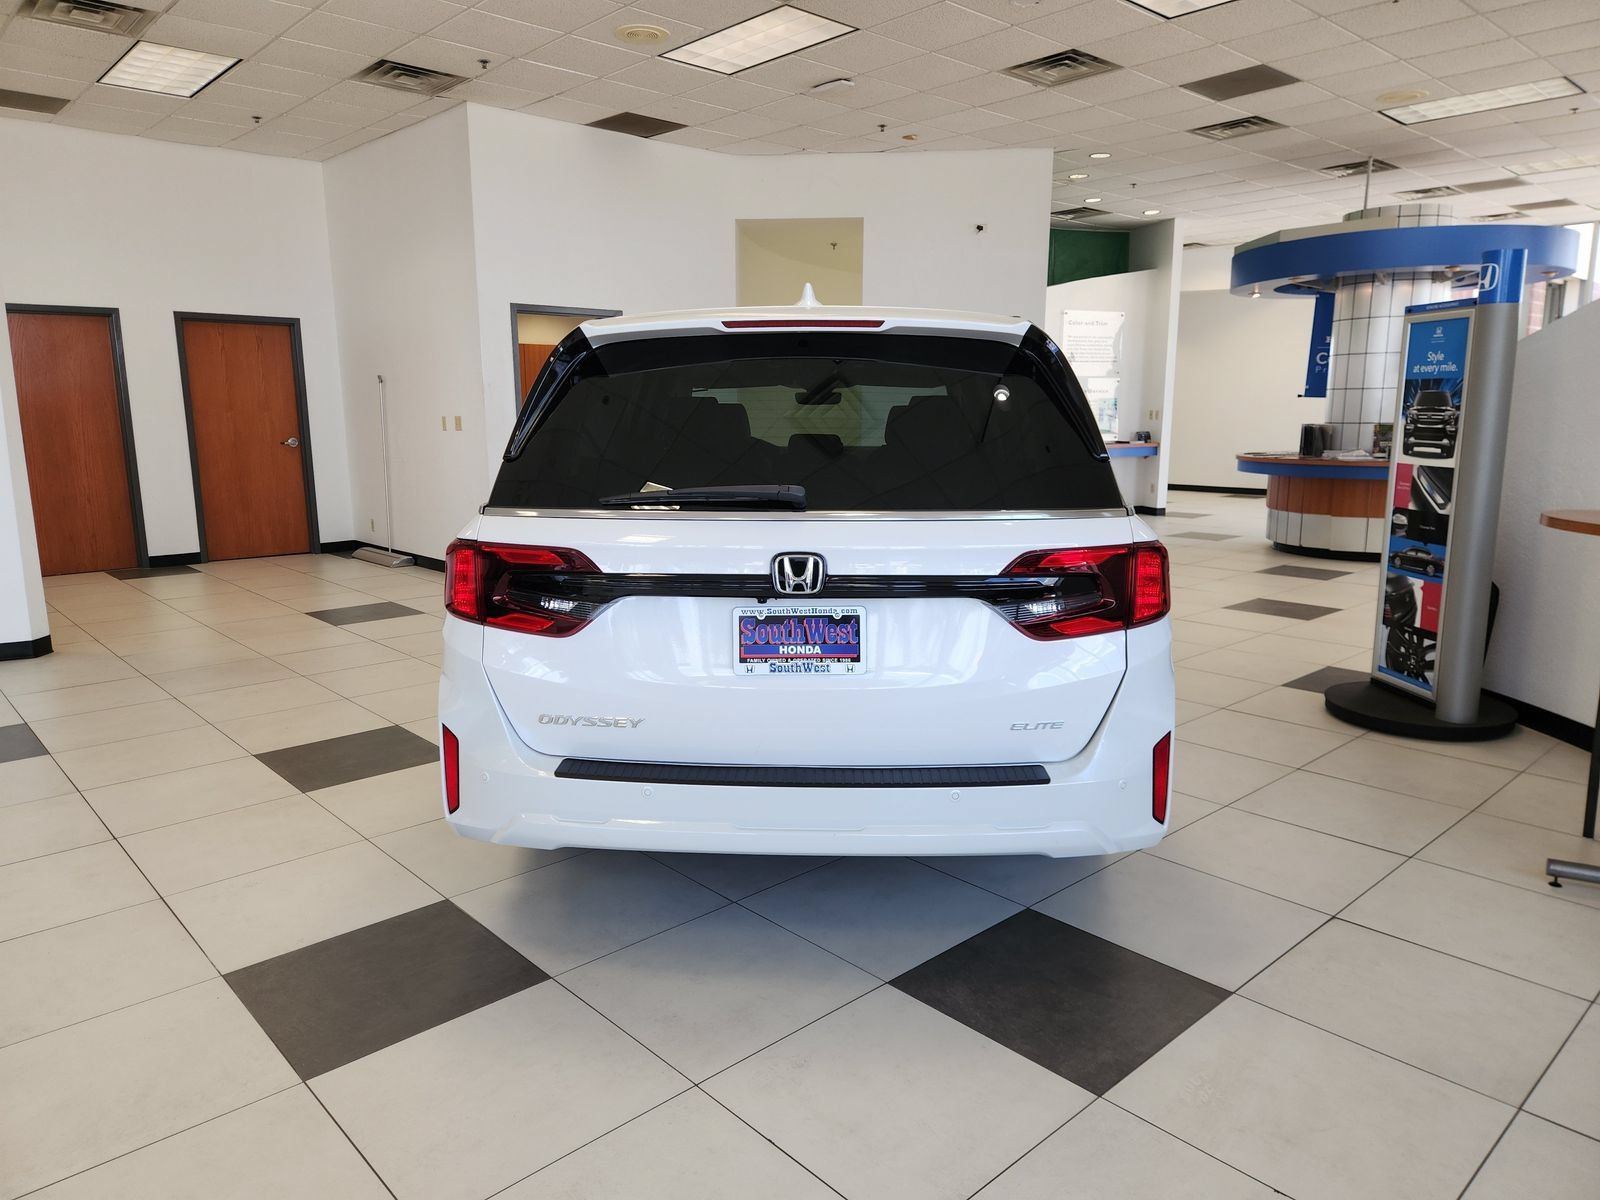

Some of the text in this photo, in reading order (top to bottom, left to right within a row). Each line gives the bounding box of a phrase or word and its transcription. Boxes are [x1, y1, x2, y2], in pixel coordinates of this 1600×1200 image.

[1427, 350, 1445, 364] Style
[1412, 361, 1458, 375] at every mile.
[741, 607, 858, 615] www.SouthWestHondacom
[740, 617, 859, 645] SouthWest
[779, 645, 822, 655] HONDA
[769, 662, 830, 673] SouthWest
[538, 713, 645, 729] ODYSSEY
[1009, 721, 1065, 731] ELITE
